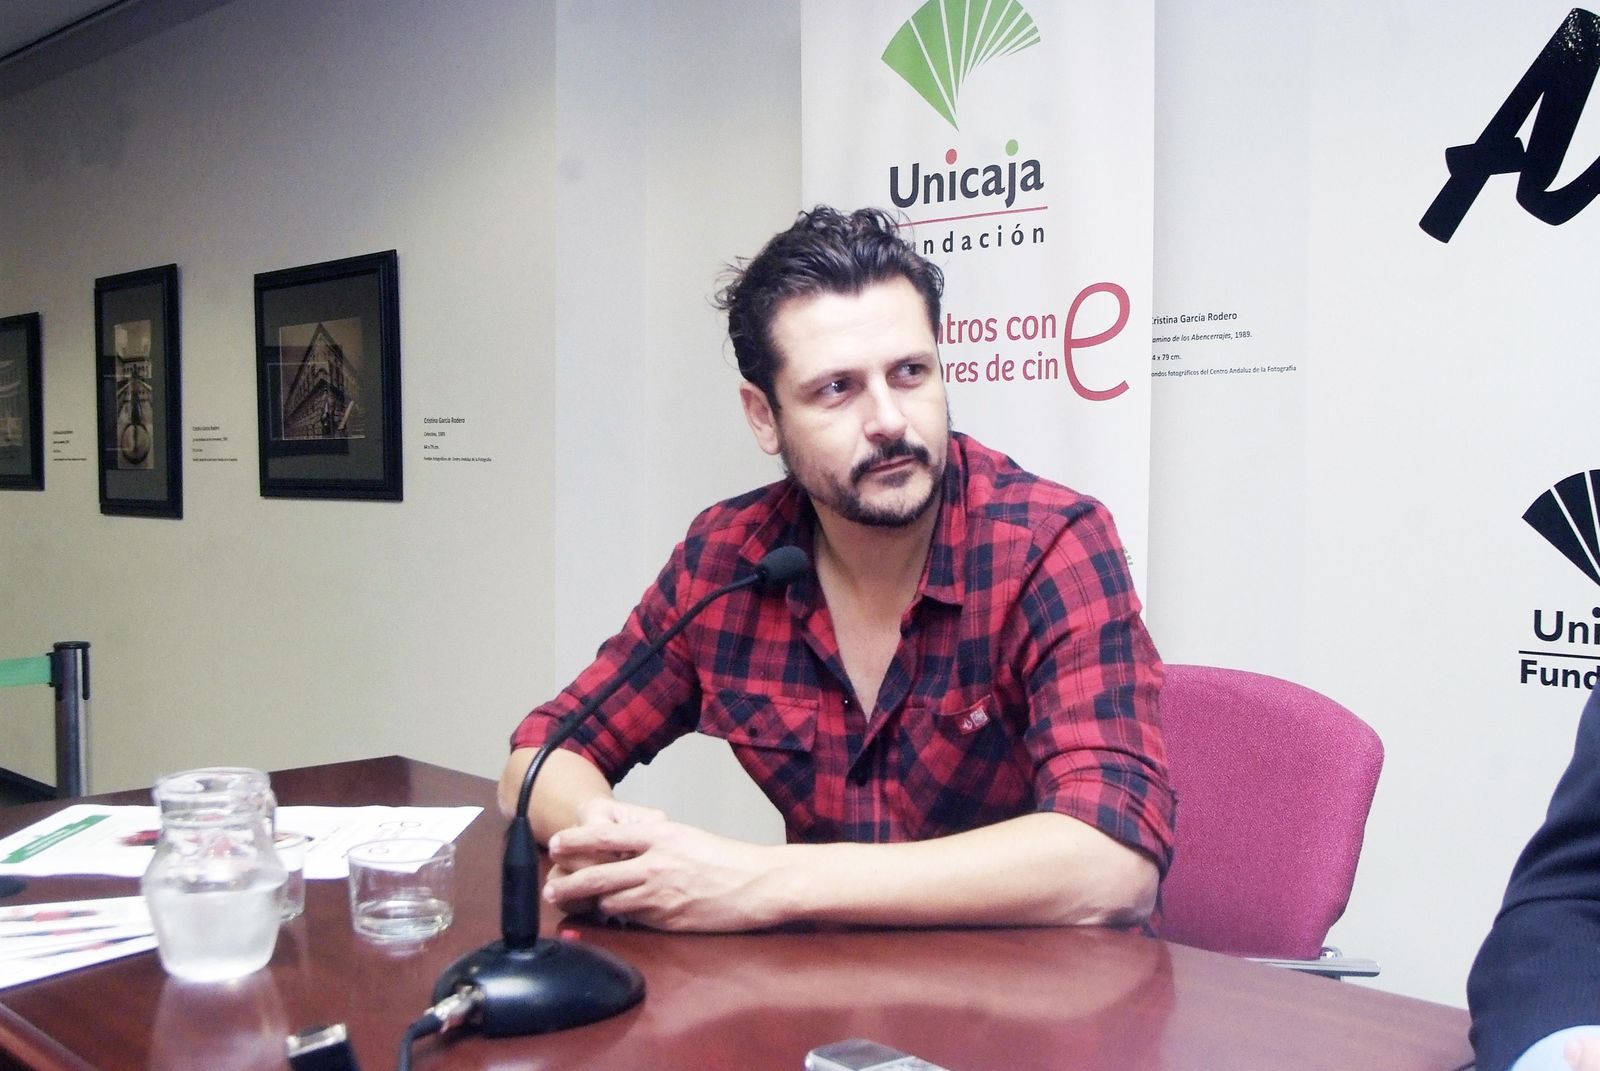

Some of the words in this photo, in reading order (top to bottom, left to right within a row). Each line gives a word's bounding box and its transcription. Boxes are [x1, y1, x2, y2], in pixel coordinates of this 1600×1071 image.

[889, 139, 1045, 208] Unicaja
[912, 223, 1045, 255] ndación
[1006, 314, 1057, 341] con
[1180, 313, 1206, 323] García
[1207, 311, 1238, 321] Rodero
[986, 354, 1015, 382] de
[1162, 353, 1170, 361] 79
